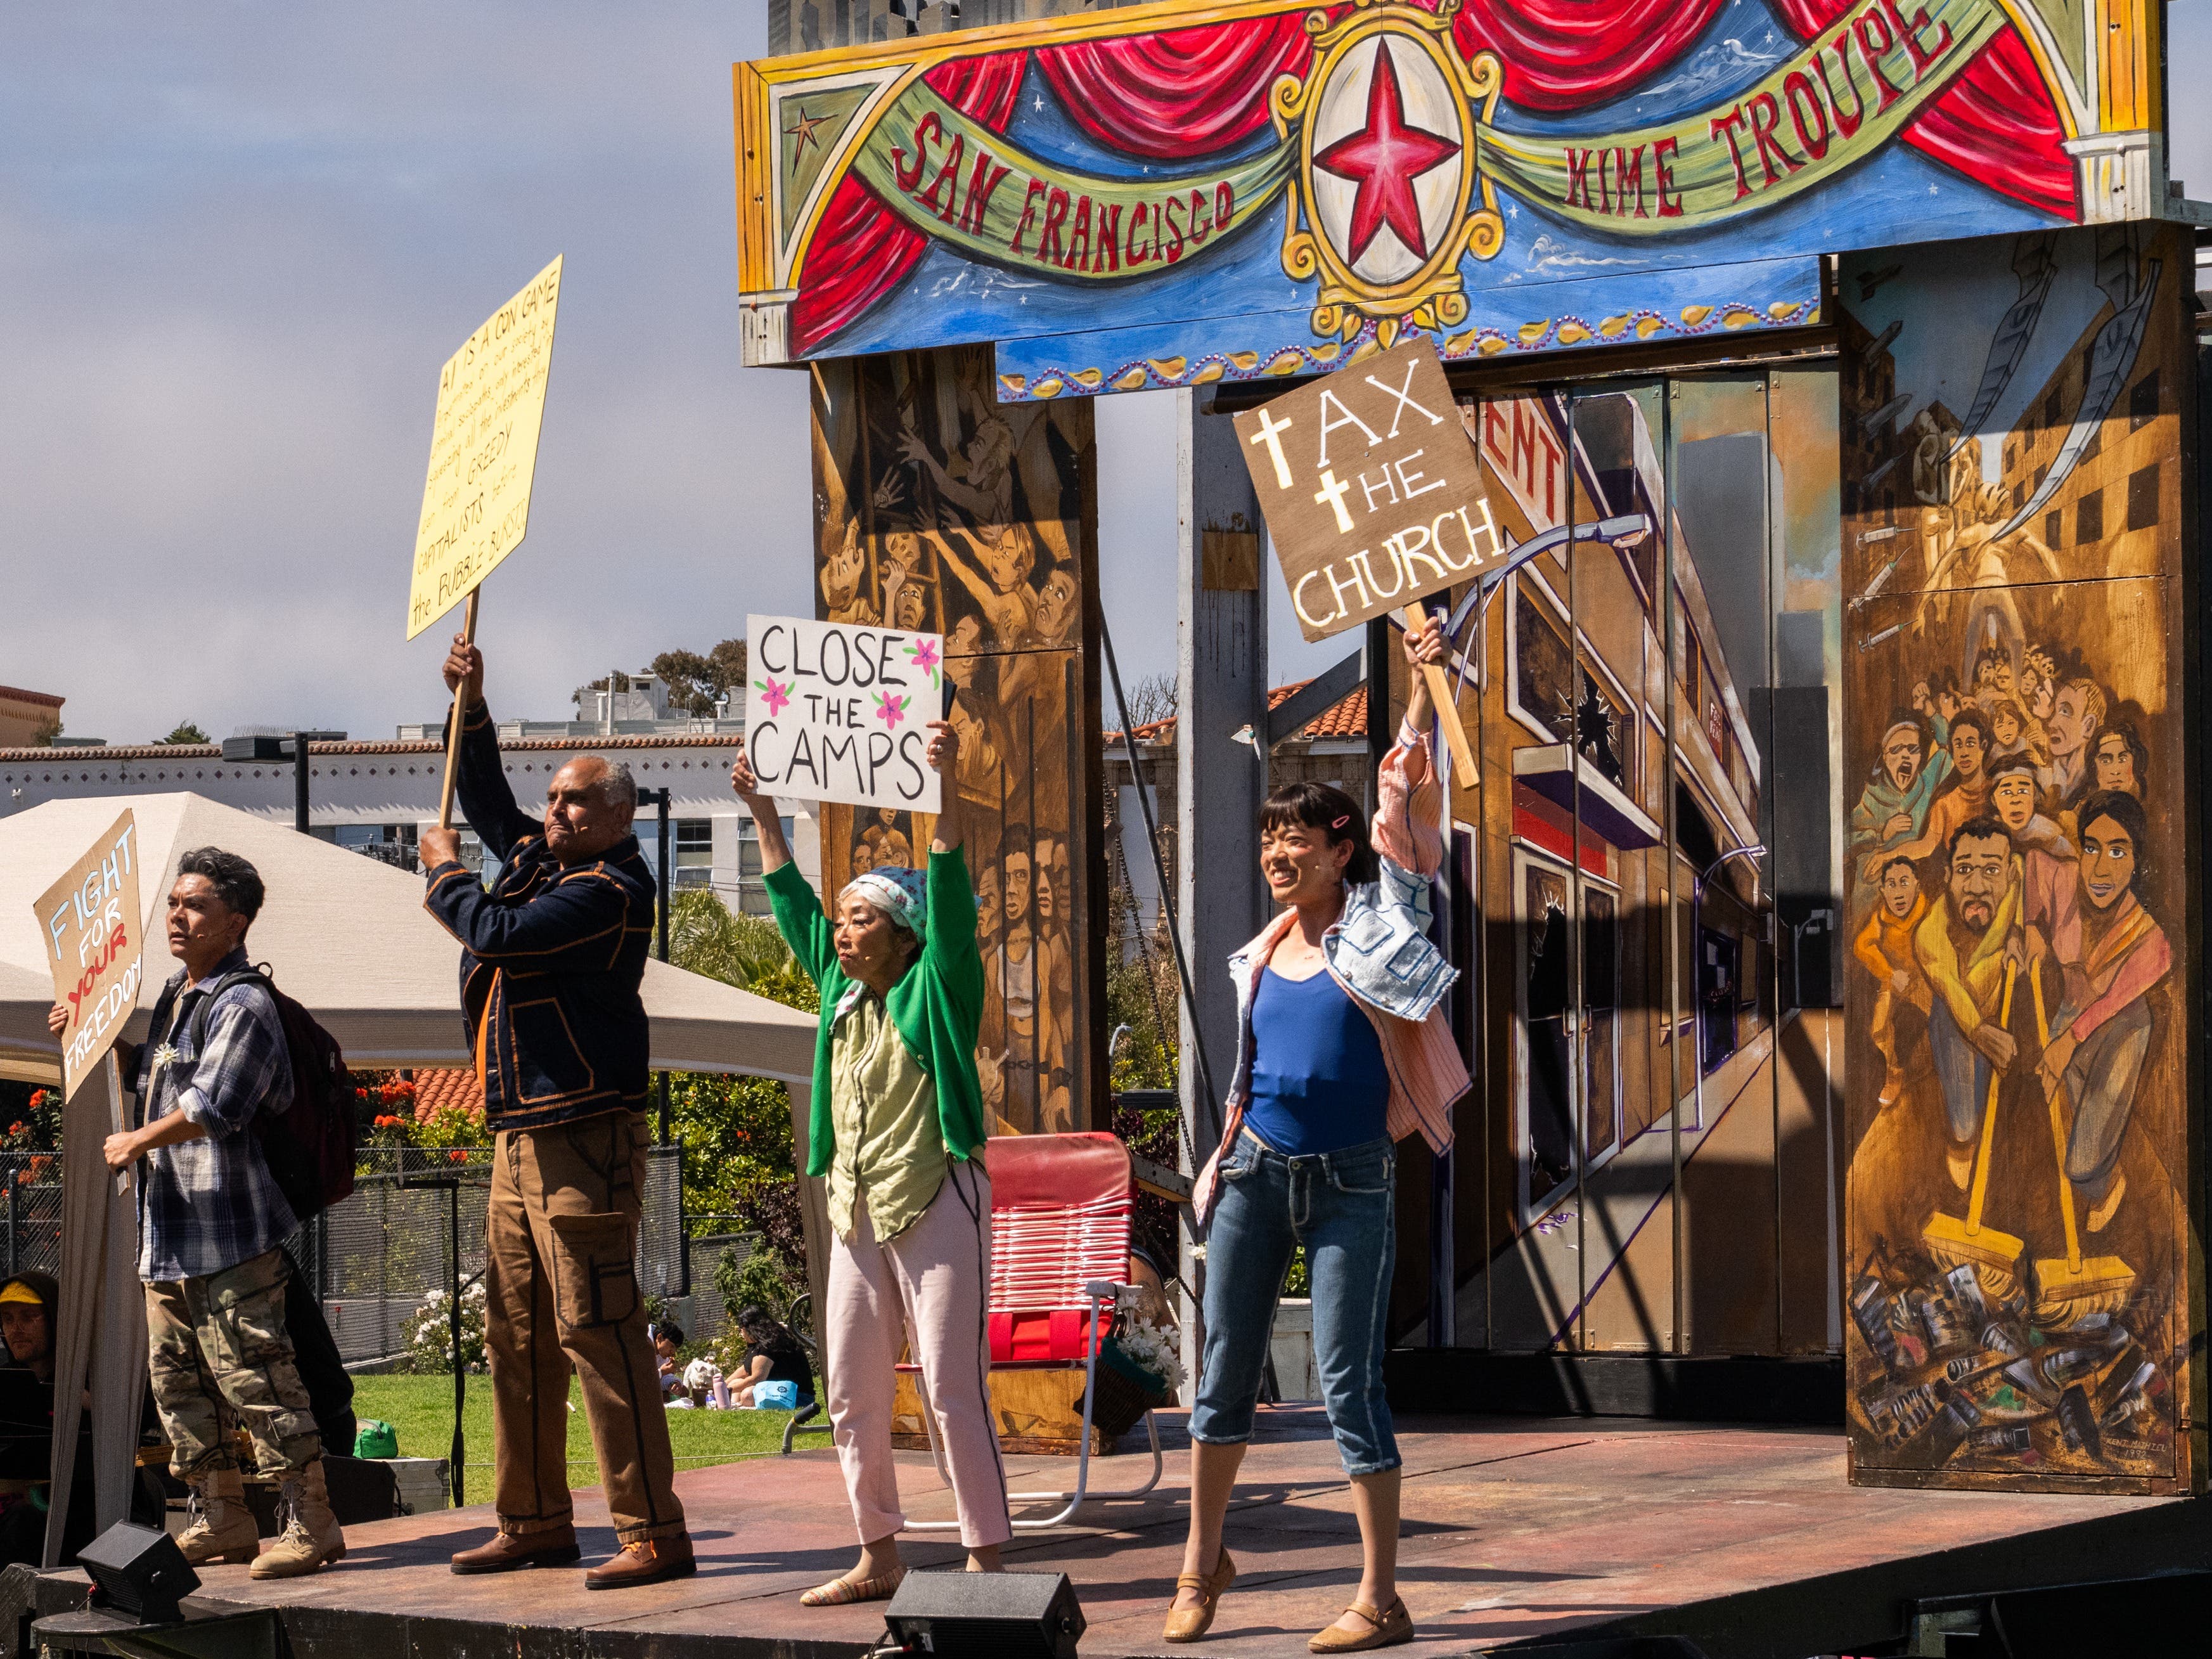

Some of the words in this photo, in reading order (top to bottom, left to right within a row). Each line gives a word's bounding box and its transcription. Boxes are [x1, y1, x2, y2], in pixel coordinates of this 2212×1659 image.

[891, 111, 1012, 238] SAN
[1010, 177, 1235, 274] FRANCISCO
[1564, 136, 1685, 219] MIME
[1708, 0, 1953, 204] TROUPE
[440, 359, 456, 403] AI
[463, 335, 475, 370] IS
[480, 325, 488, 353] A
[495, 300, 518, 339] CON
[522, 269, 557, 318] GAME
[465, 415, 476, 449] all
[480, 408, 492, 437] the
[468, 421, 513, 485] GREEDY
[1459, 396, 1560, 526] ENT
[418, 492, 484, 574] CAPITALISTS
[1293, 498, 1506, 628] CHURCH
[413, 593, 432, 626] the
[439, 540, 485, 606] BUBBLE
[759, 624, 908, 688] CLOSE
[804, 694, 866, 729] THE
[750, 720, 925, 801] CAMPS
[48, 823, 134, 961] FIGHT
[78, 896, 122, 969] FOR
[68, 922, 128, 1028] YOUR
[64, 952, 143, 1083] FREEDOM
[2105, 1437, 2129, 1448] KENT
[2125, 1449, 2147, 1459] 1992
